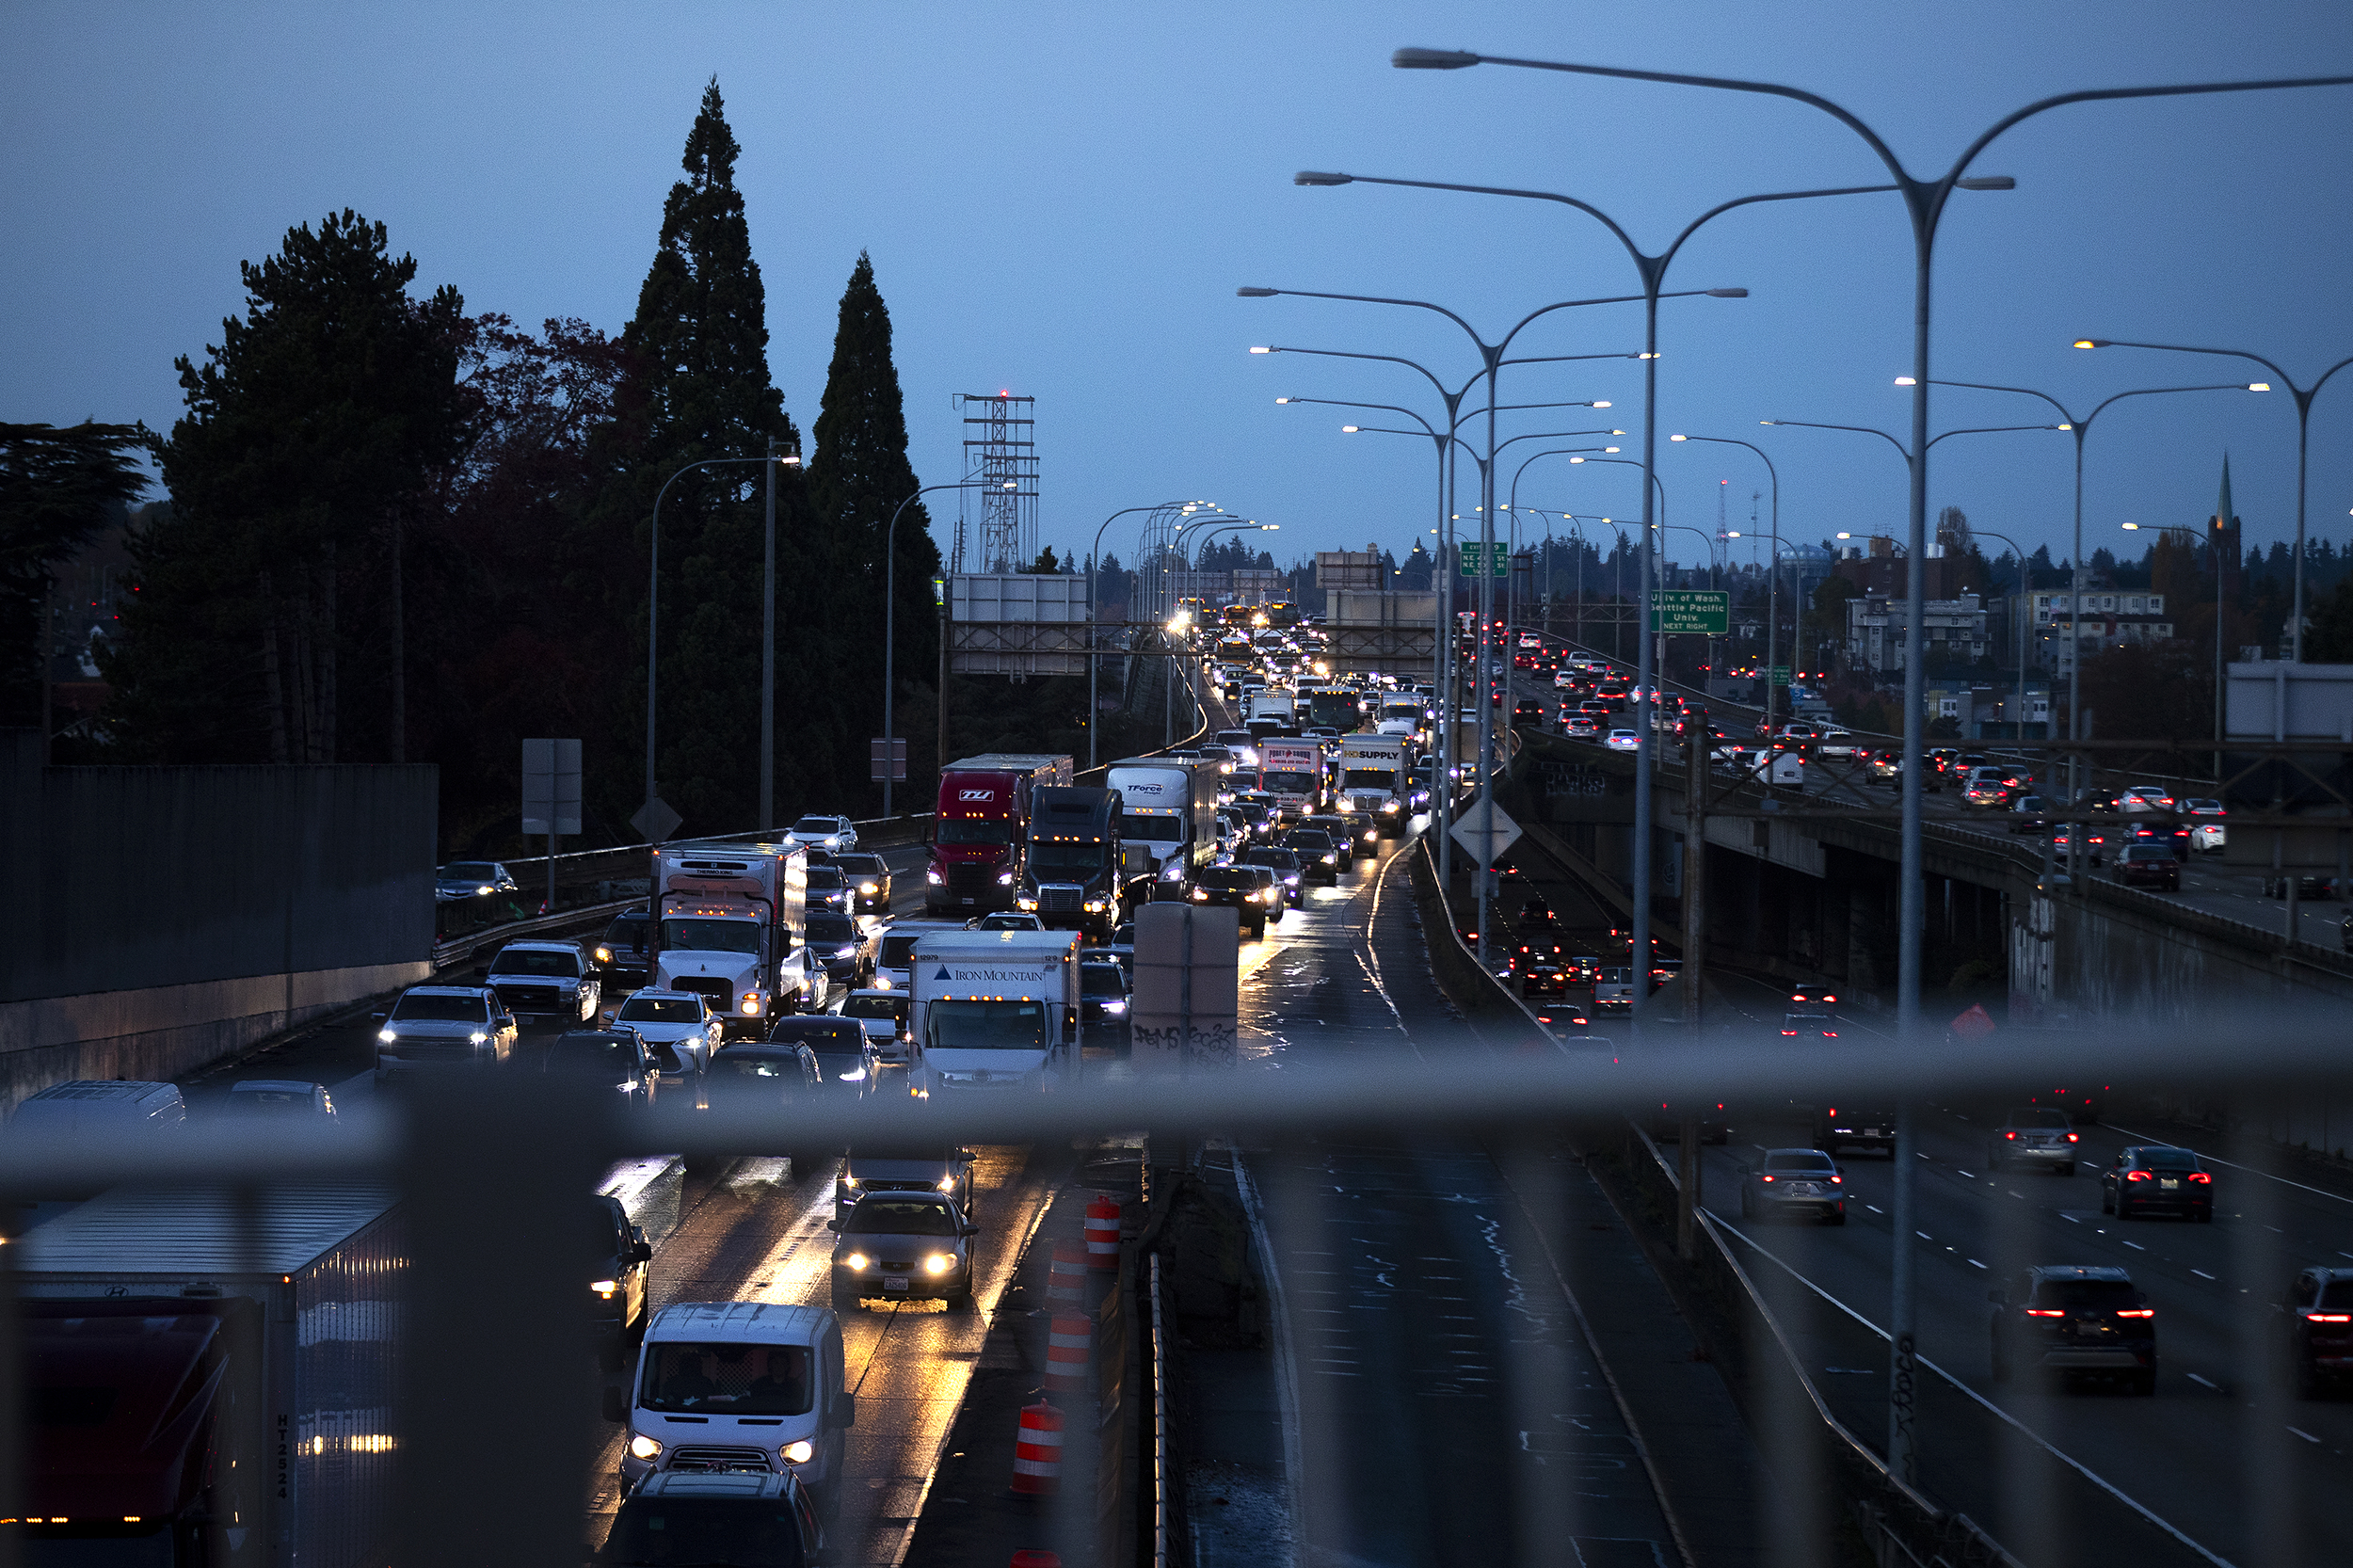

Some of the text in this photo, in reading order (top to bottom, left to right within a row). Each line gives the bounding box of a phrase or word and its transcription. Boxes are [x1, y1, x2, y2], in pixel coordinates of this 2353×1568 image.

[1650, 593, 1722, 603] Uiv. of Wash.
[1689, 603, 1725, 613] Pacific
[1673, 613, 1699, 622] Univ.
[955, 969, 1043, 982] IRON MOUNTAIN
[277, 1414, 288, 1499] HT2524
